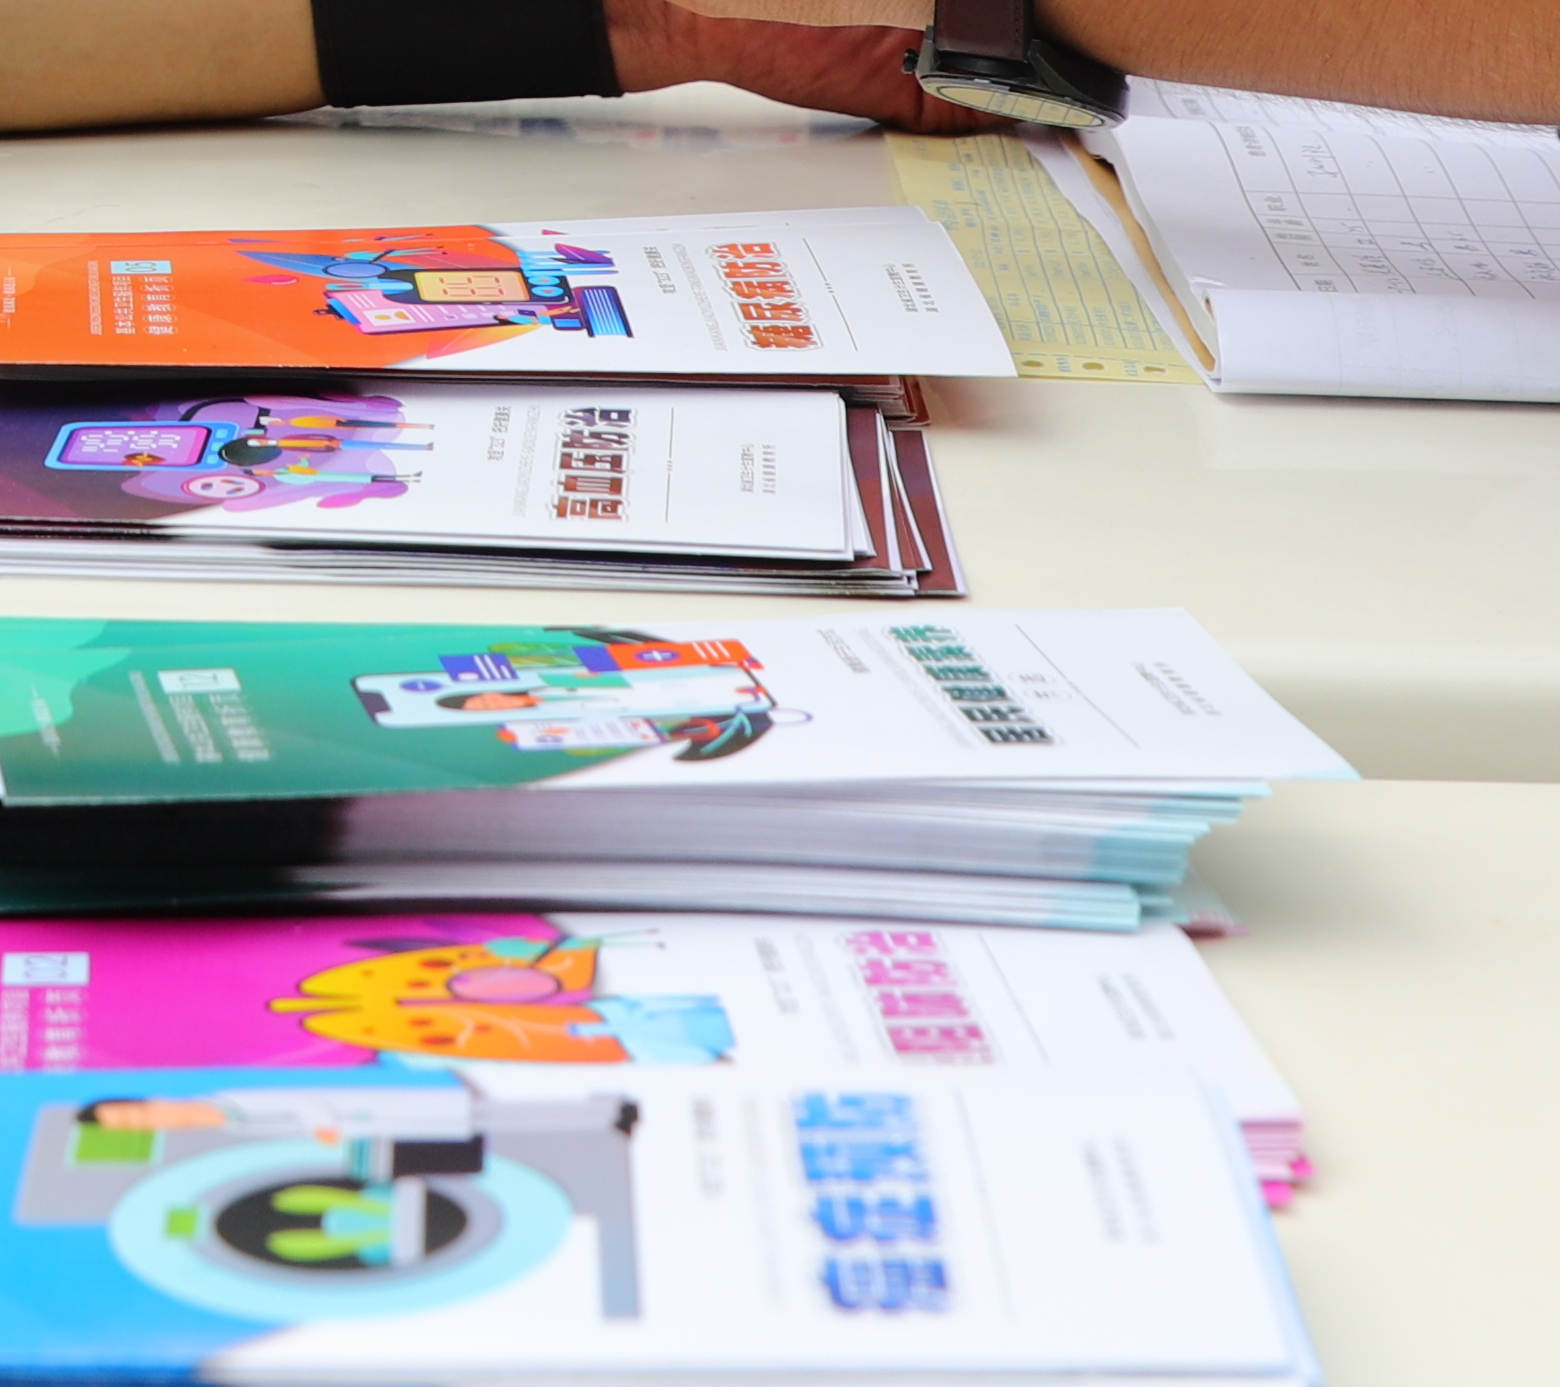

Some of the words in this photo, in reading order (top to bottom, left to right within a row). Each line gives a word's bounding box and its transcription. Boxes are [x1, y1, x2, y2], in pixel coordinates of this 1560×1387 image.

[125, 261, 158, 273] 05
[708, 241, 822, 352] 糖尿病防治
[551, 405, 633, 522] 高血压防治
